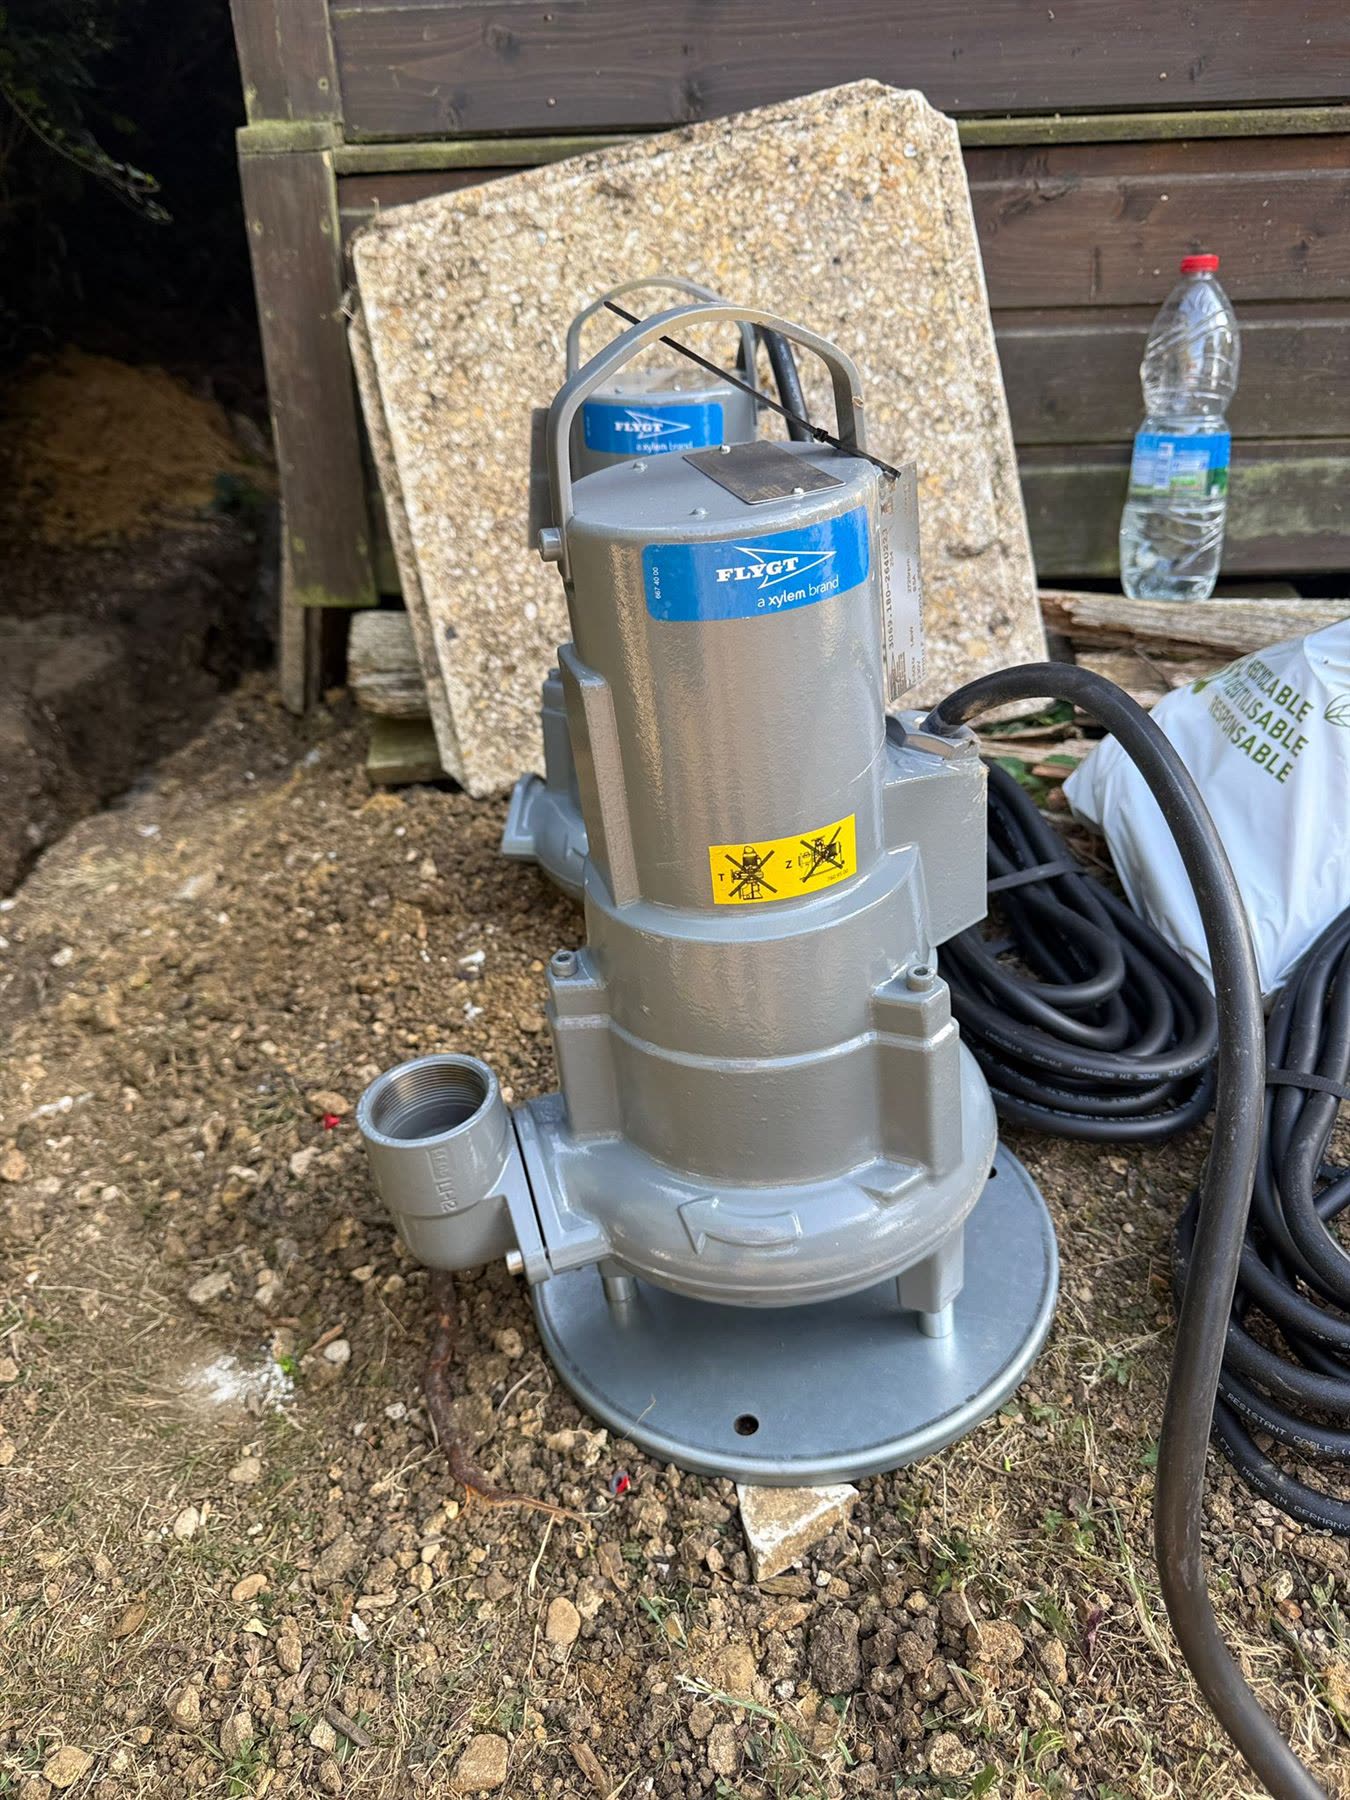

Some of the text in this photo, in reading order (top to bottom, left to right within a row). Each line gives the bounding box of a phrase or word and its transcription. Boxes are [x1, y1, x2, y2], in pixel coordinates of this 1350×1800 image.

[614, 421, 664, 433] FLYGT
[669, 441, 694, 450] brand
[652, 567, 659, 576] 00
[716, 557, 798, 582] FLYGT
[653, 576, 660, 586] 40
[757, 575, 839, 608] a xylem brand
[1209, 696, 1293, 784] RESPONSABLE
[785, 860, 792, 869] Z
[718, 873, 725, 882] T
[1072, 1065, 1115, 1079] GERMANY
[1119, 1072, 1132, 1080] IN
[1136, 1071, 1160, 1080] MADE
[1227, 1392, 1287, 1436] RESISTANT
[1242, 1466, 1268, 1490] MADE
[1274, 1493, 1287, 1505] IN
[1294, 1505, 1350, 1531] GERMANY
